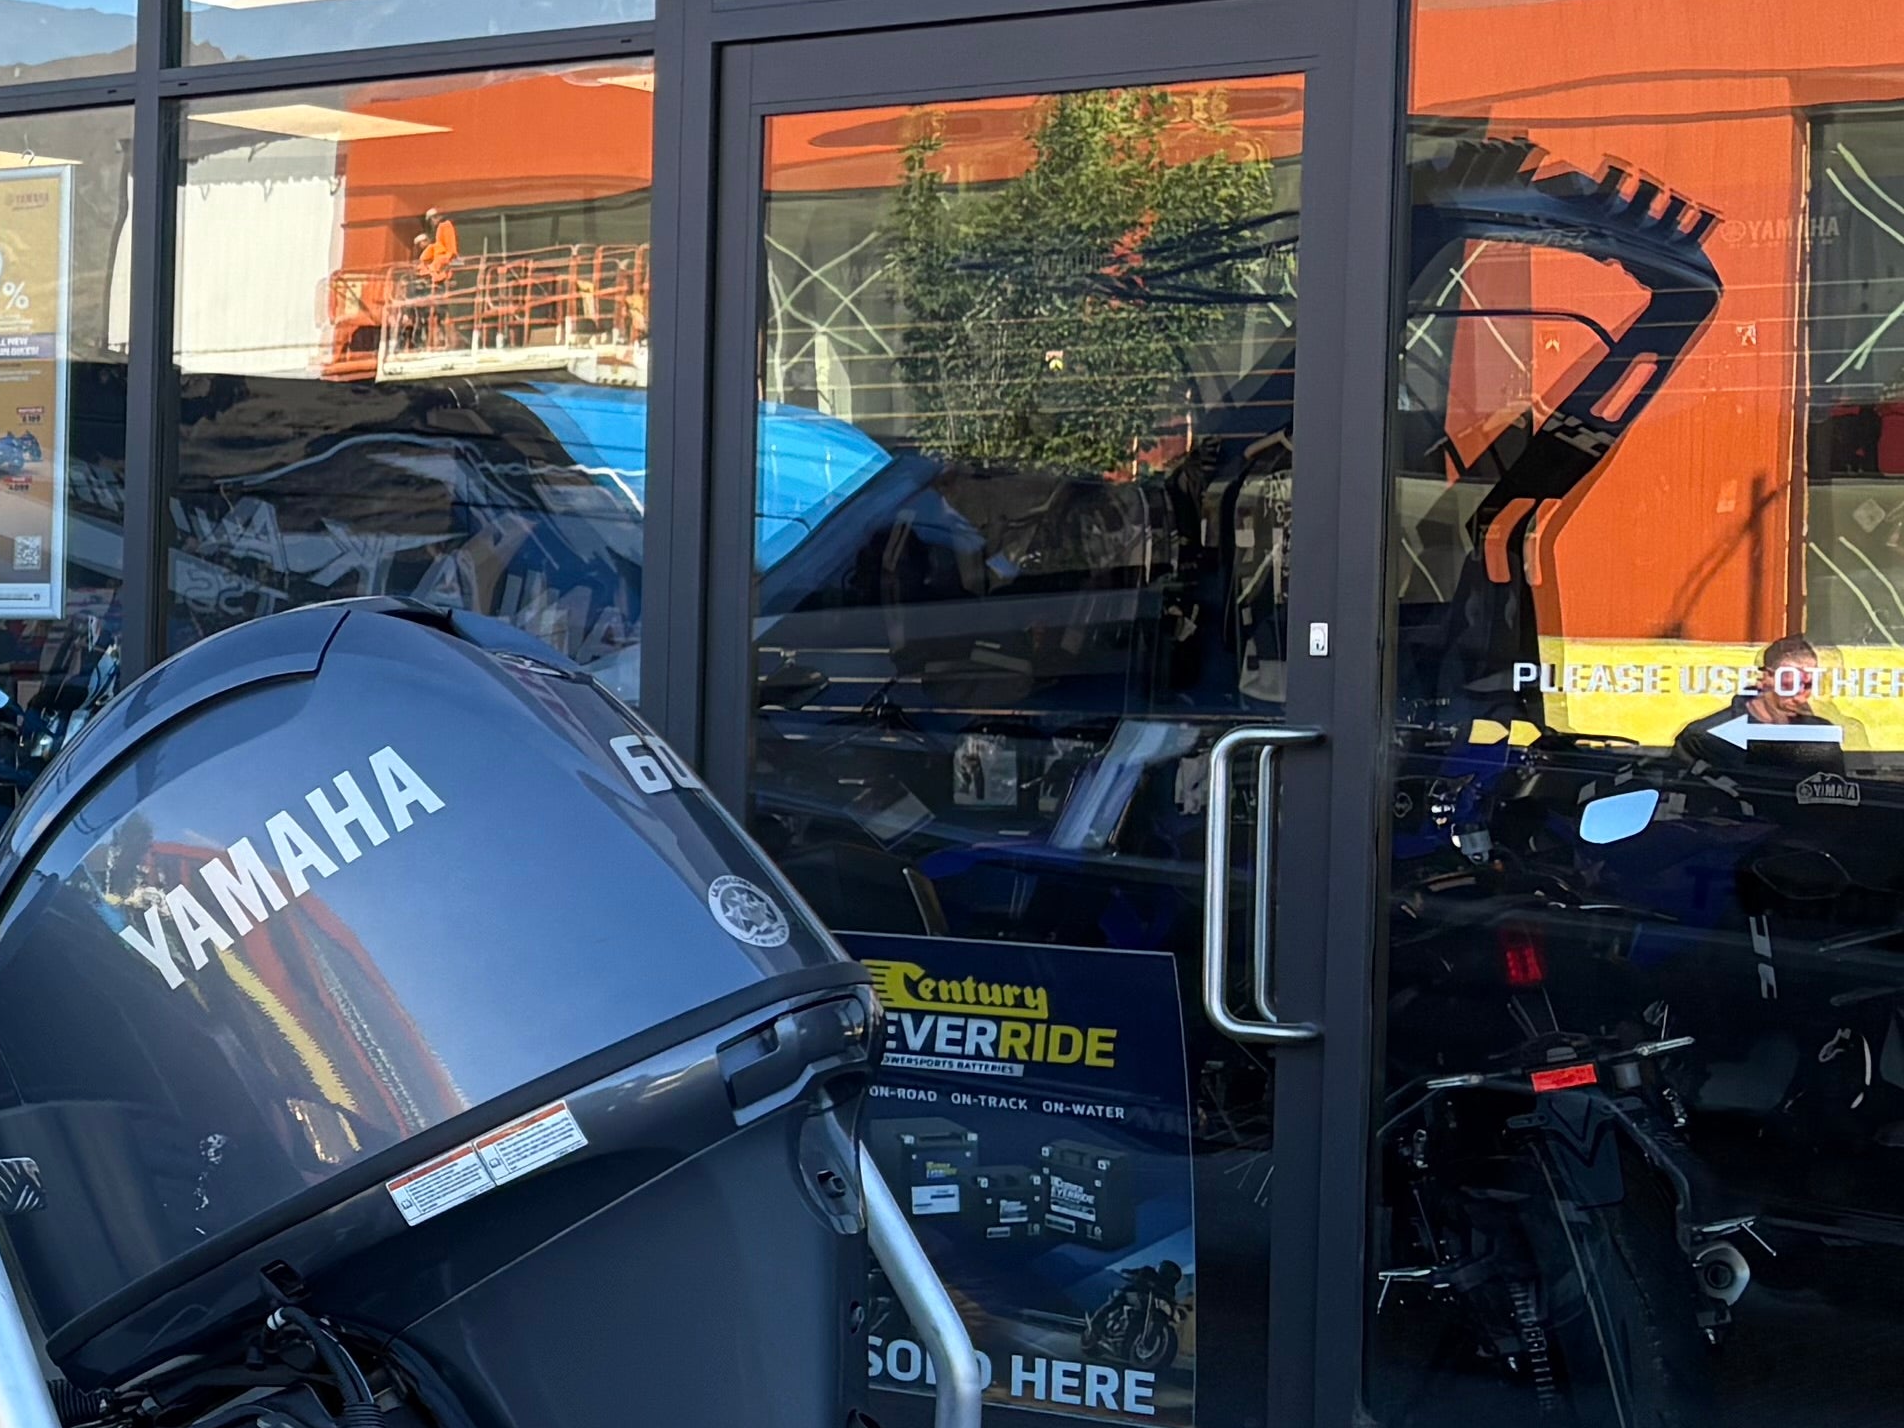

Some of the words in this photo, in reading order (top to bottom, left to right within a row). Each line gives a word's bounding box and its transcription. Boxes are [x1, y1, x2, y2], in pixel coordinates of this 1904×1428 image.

[1748, 216, 1840, 241] YAMHA
[1512, 662, 1670, 694] PLEASE
[1679, 664, 1761, 697] USE
[609, 734, 704, 794] 60
[119, 745, 446, 991] YAMAHA
[861, 959, 1049, 1019] Century
[869, 1086, 937, 1103] ON-ROAD
[951, 1092, 1028, 1111] ON-TRACK
[1041, 1100, 1125, 1120] ON-WATER
[1010, 1354, 1156, 1416] HERE
